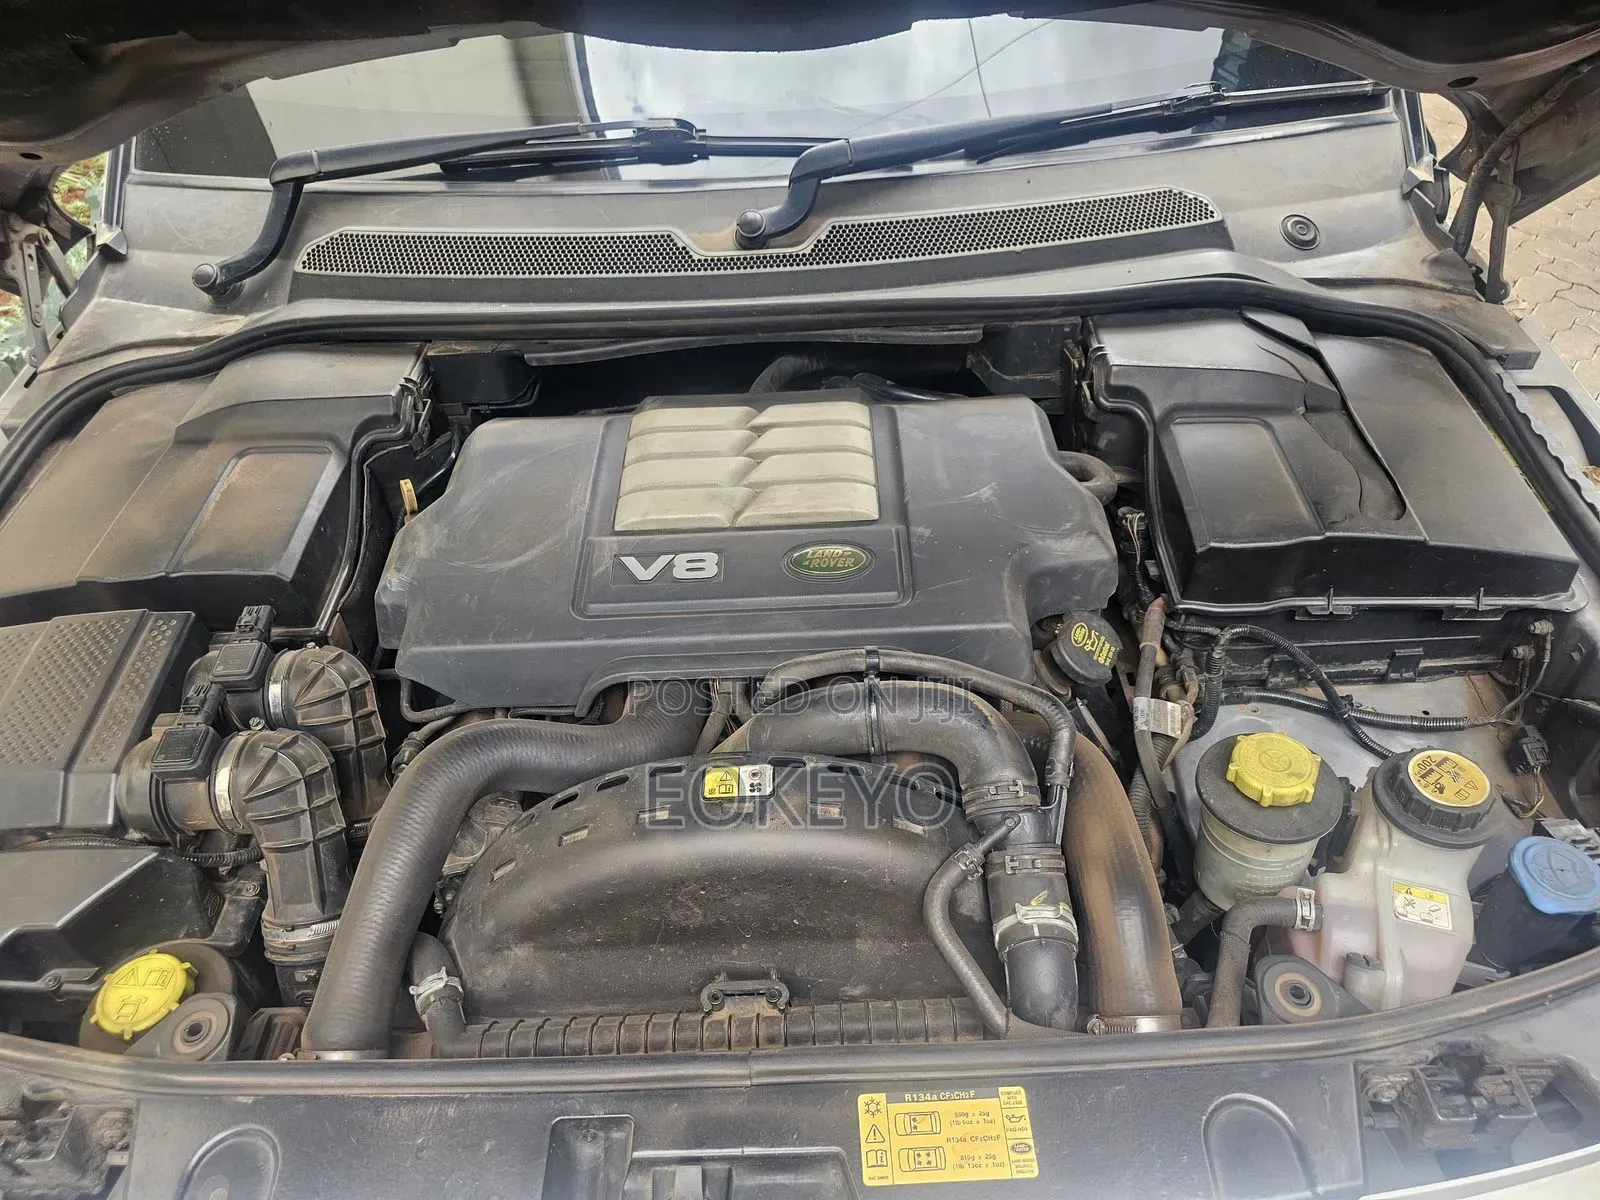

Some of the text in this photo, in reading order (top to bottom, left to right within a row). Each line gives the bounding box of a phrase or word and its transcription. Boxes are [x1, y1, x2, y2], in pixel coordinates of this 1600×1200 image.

[807, 550, 844, 559] LAND
[619, 552, 719, 581] V8
[810, 557, 855, 568] ROVER
[905, 1093, 937, 1102] R134a
